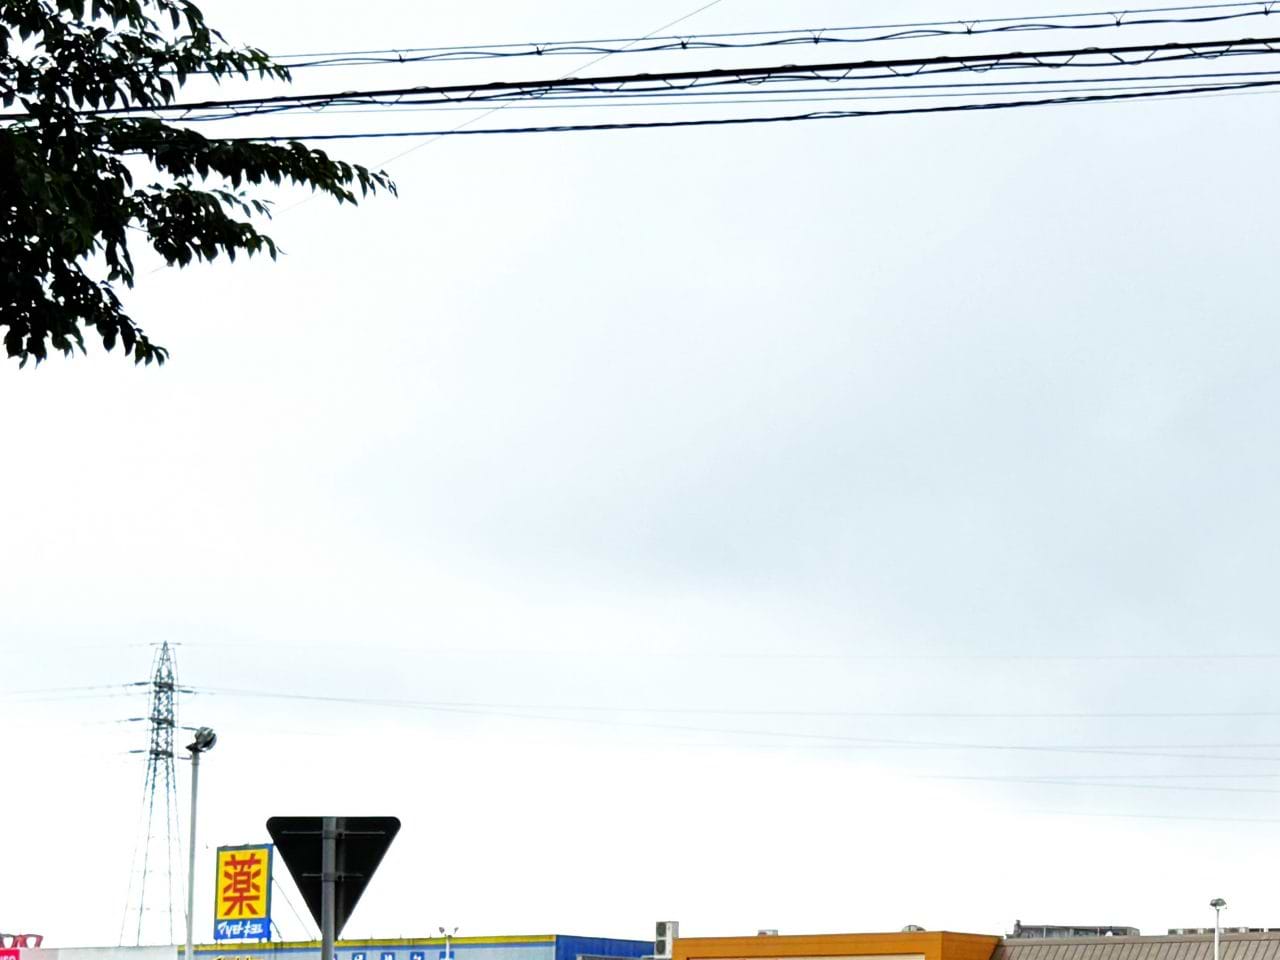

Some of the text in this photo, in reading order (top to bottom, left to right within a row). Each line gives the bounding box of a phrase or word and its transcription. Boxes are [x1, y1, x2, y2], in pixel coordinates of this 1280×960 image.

[223, 853, 262, 916] 薬
[217, 920, 264, 938] マツモトキヨシ
